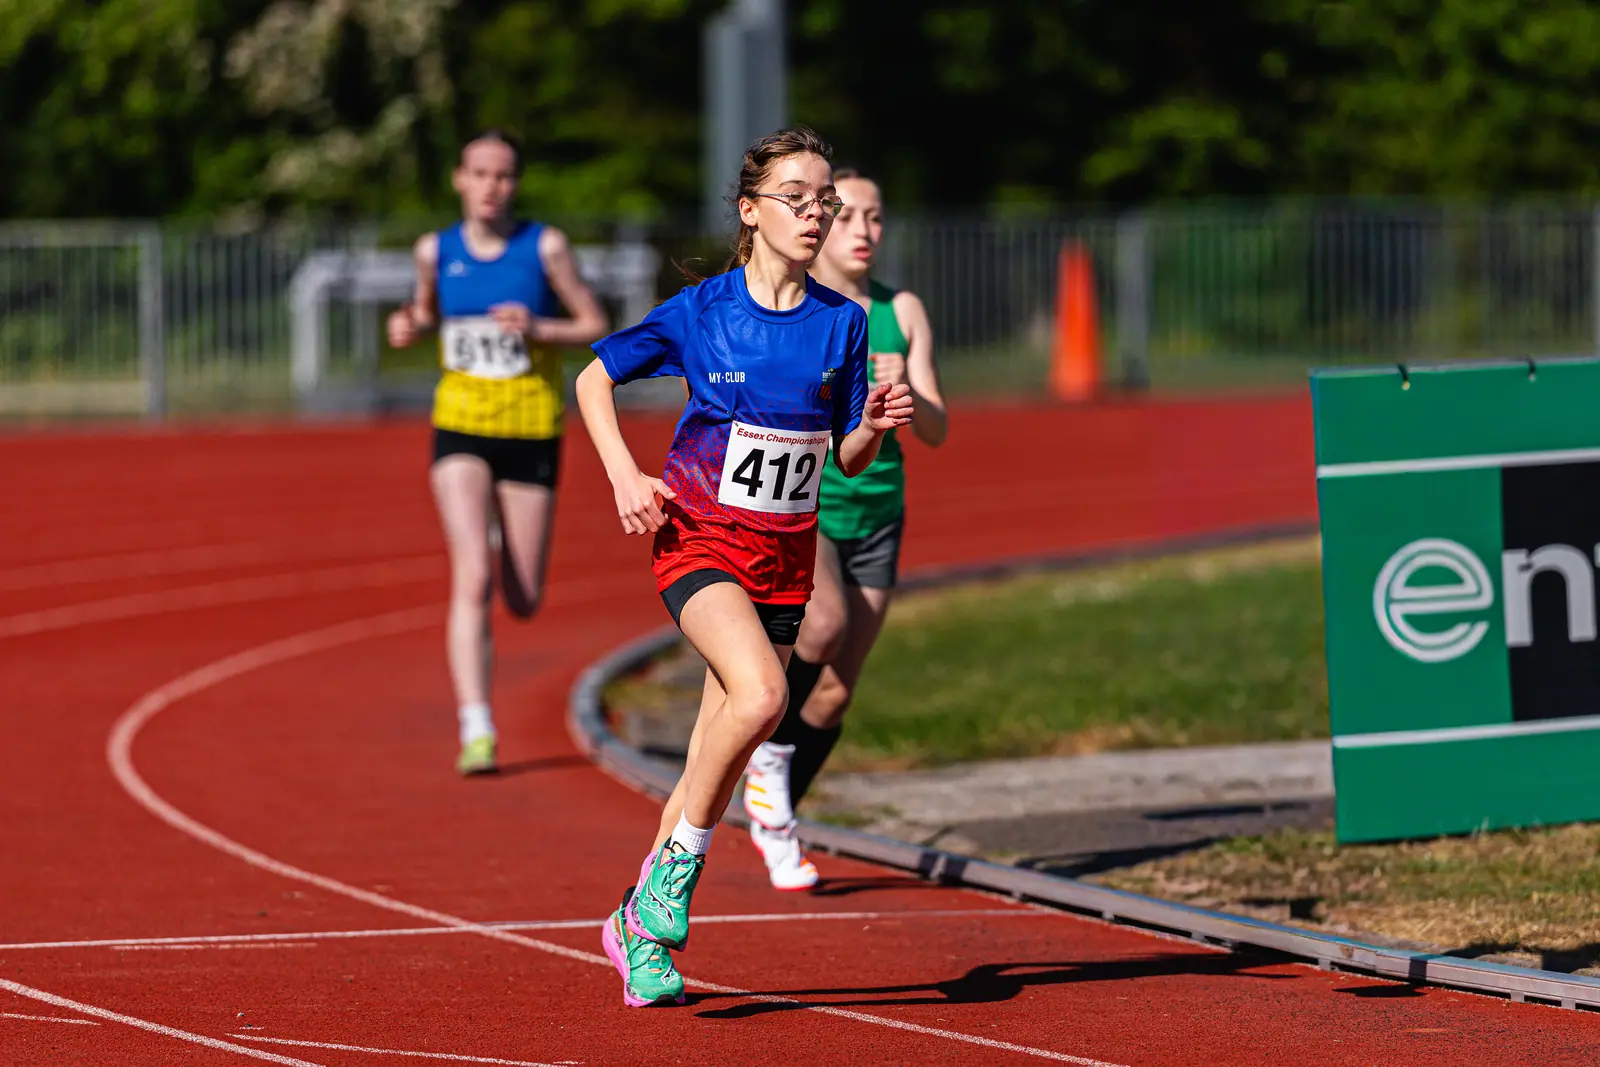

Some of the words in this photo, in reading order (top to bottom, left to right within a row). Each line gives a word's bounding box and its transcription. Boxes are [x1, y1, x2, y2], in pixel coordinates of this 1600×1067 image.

[736, 427, 765, 441] Essex
[766, 433, 827, 446] Championships
[731, 448, 817, 501] 412
[1372, 537, 1600, 664] en
